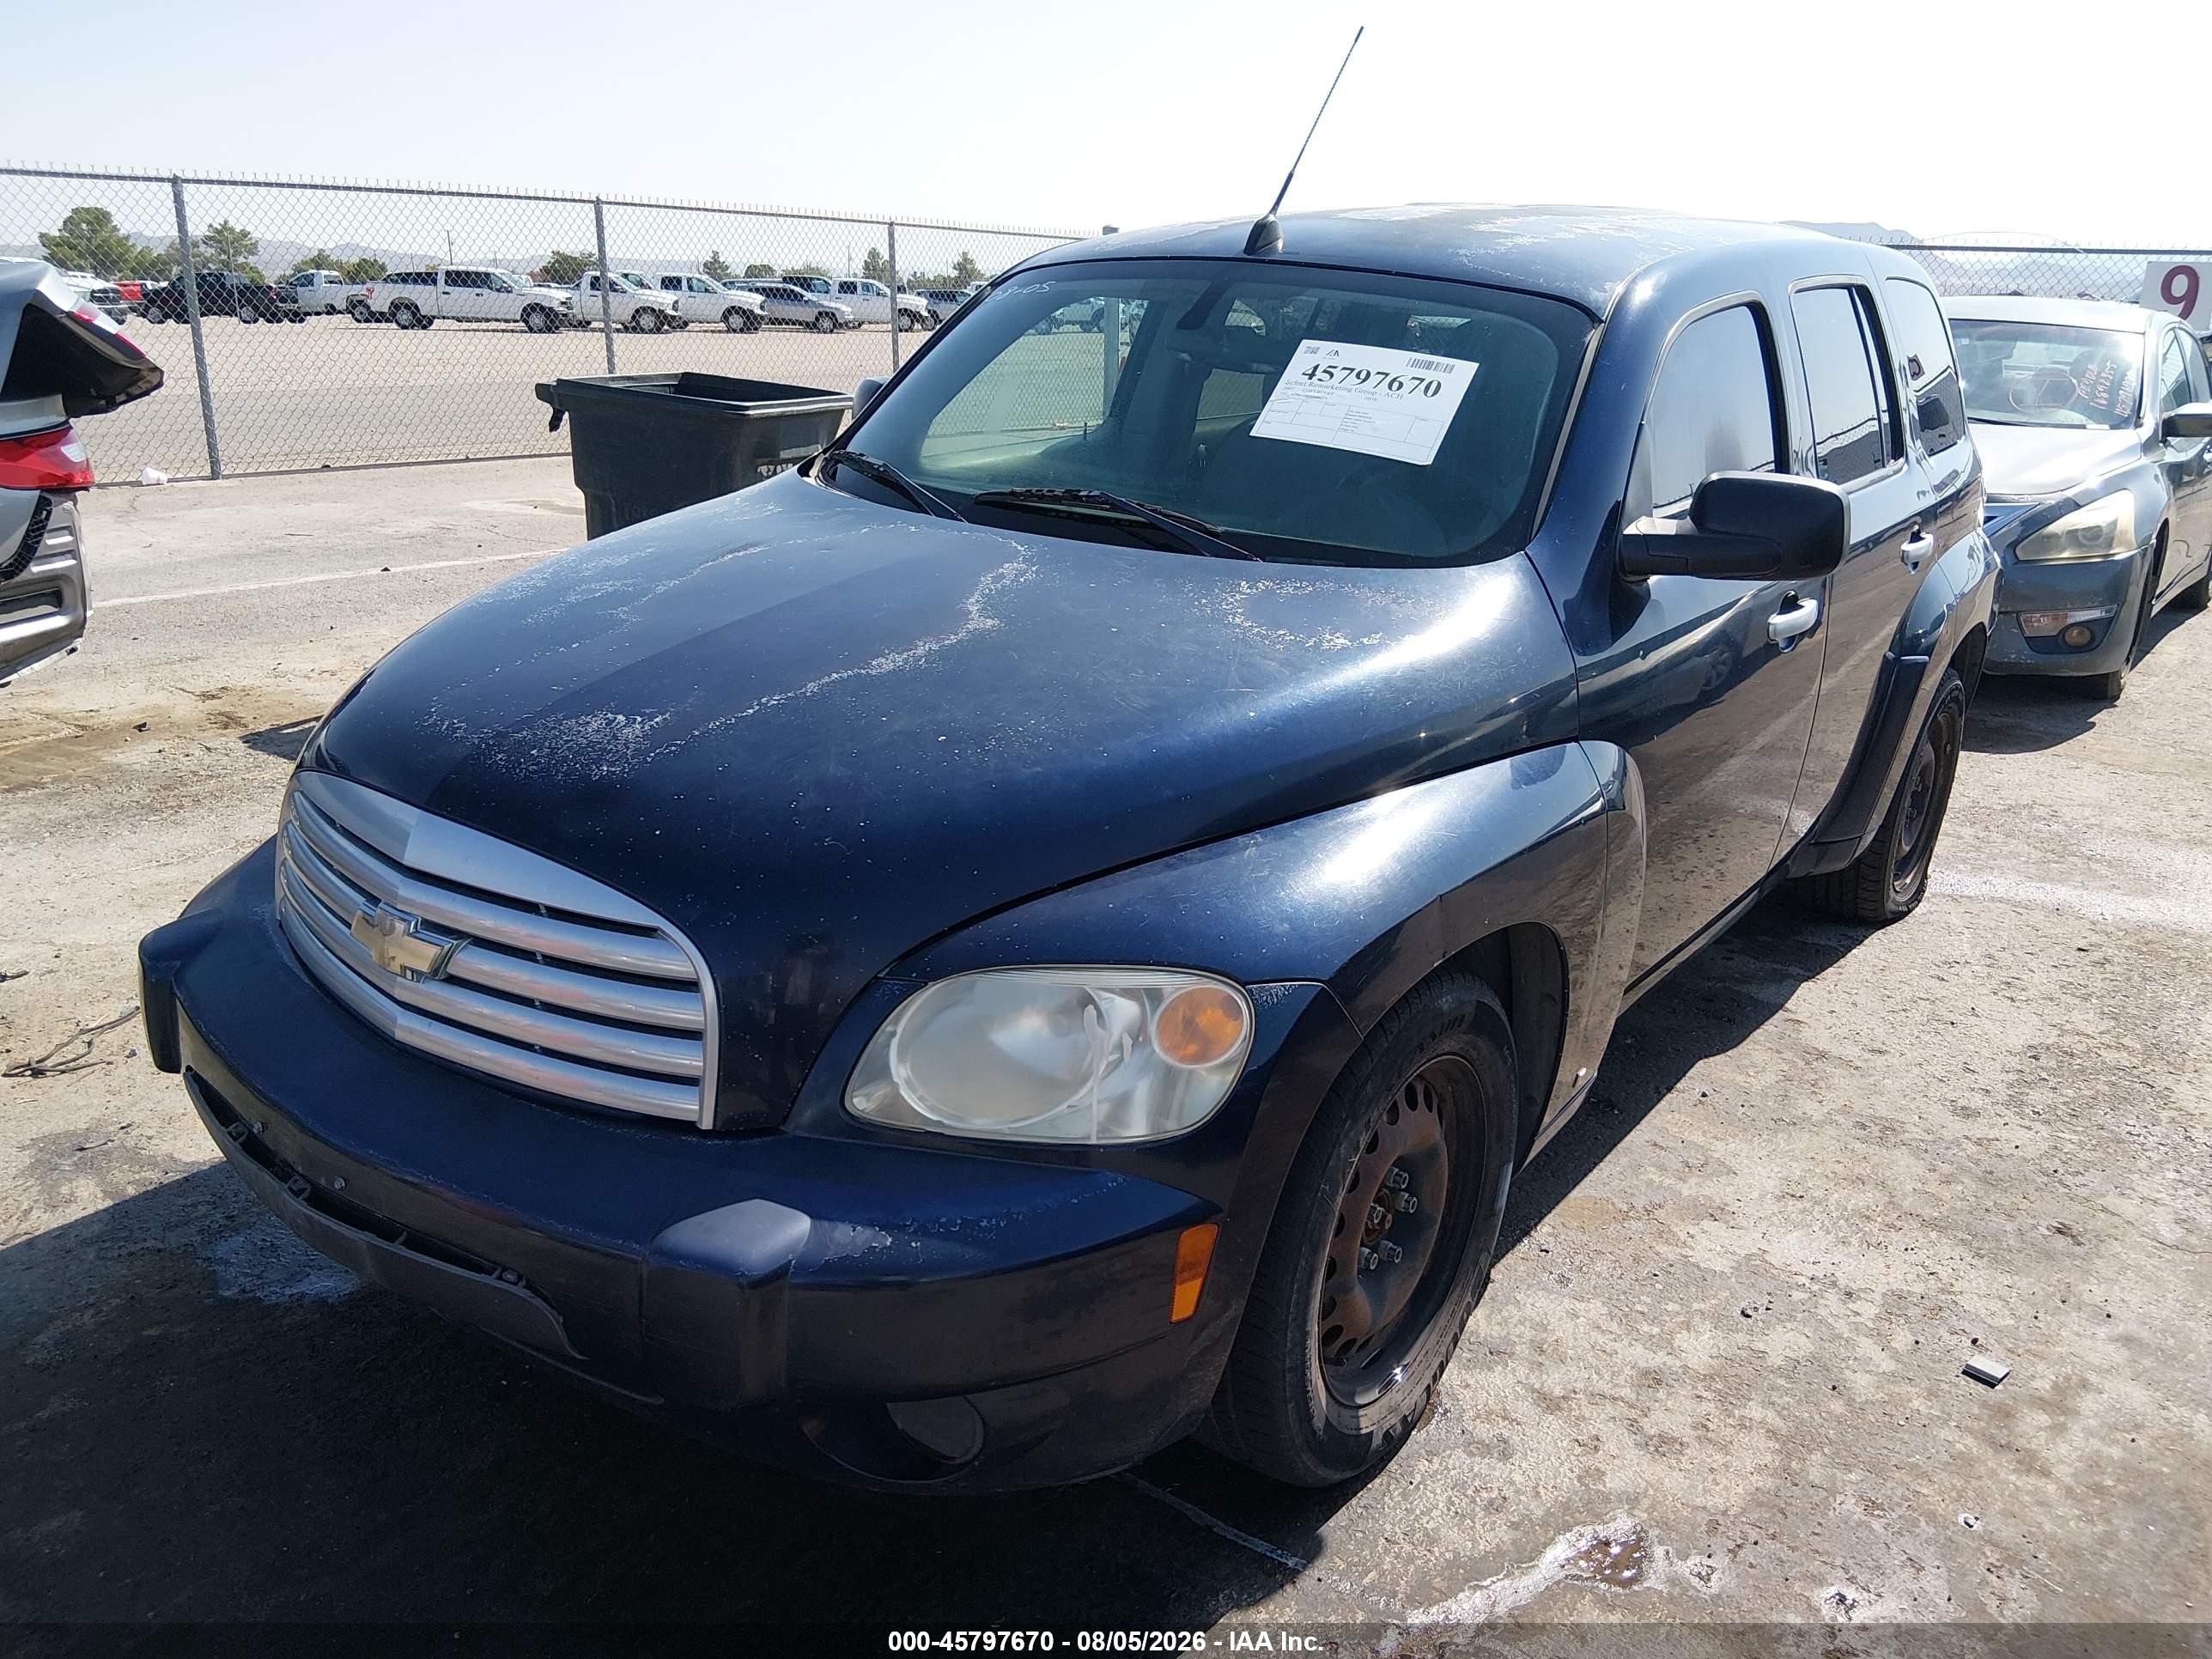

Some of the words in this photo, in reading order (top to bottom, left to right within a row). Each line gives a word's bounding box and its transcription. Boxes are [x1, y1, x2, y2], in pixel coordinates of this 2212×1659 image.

[2161, 264, 2199, 320] 9
[1301, 363, 1442, 398] 45797670
[1308, 380, 1352, 392] Remarketing
[1354, 387, 1377, 396] Group
